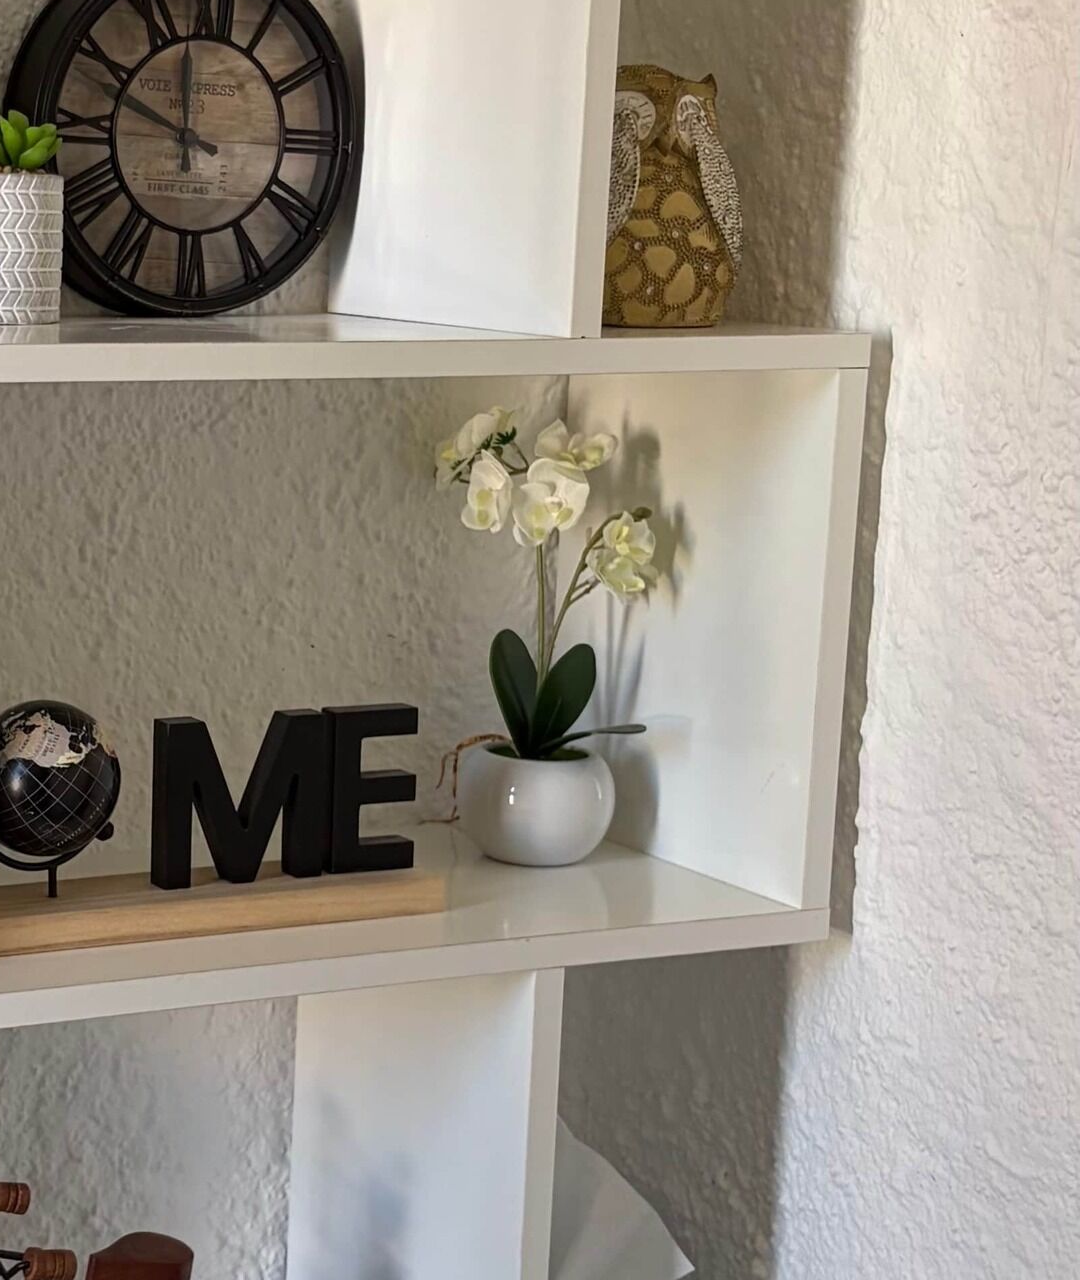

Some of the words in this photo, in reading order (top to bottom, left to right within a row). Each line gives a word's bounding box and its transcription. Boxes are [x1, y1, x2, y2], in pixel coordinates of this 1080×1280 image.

[139, 78, 172, 93] VOIE
[284, 128, 337, 156] III
[147, 182, 177, 193] FIRST
[178, 184, 210, 195] CLASS
